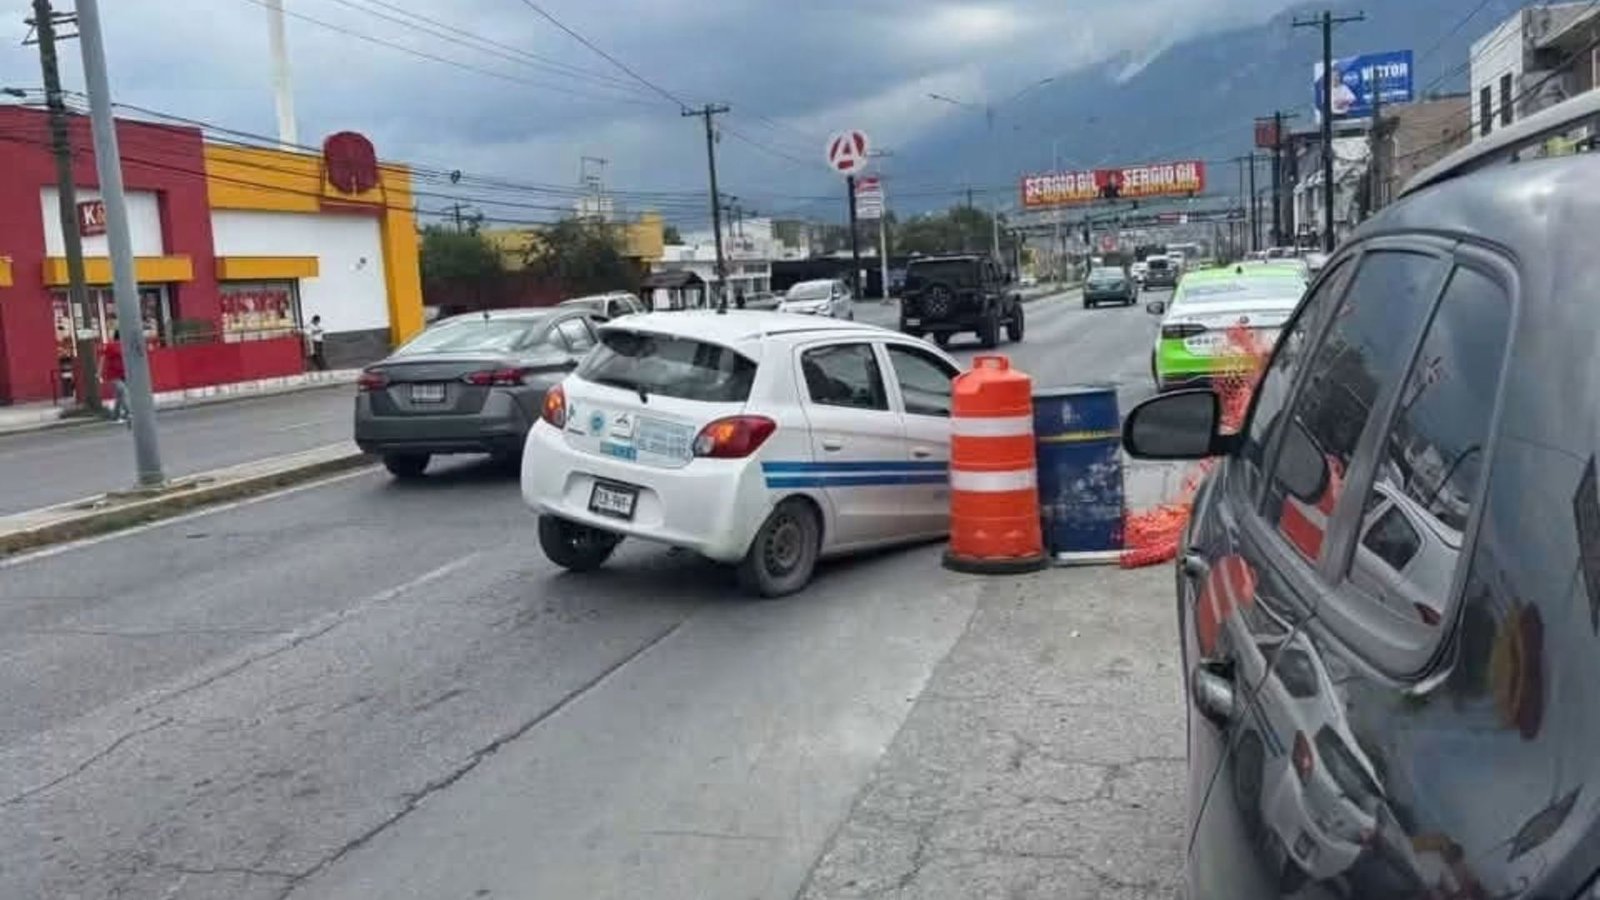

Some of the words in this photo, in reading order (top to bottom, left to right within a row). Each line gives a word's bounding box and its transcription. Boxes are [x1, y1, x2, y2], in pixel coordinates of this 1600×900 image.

[1361, 63, 1409, 80] VITOR
[1025, 173, 1075, 198] SERGIO
[1122, 165, 1174, 187] SERGIO
[1176, 162, 1200, 184] GIL
